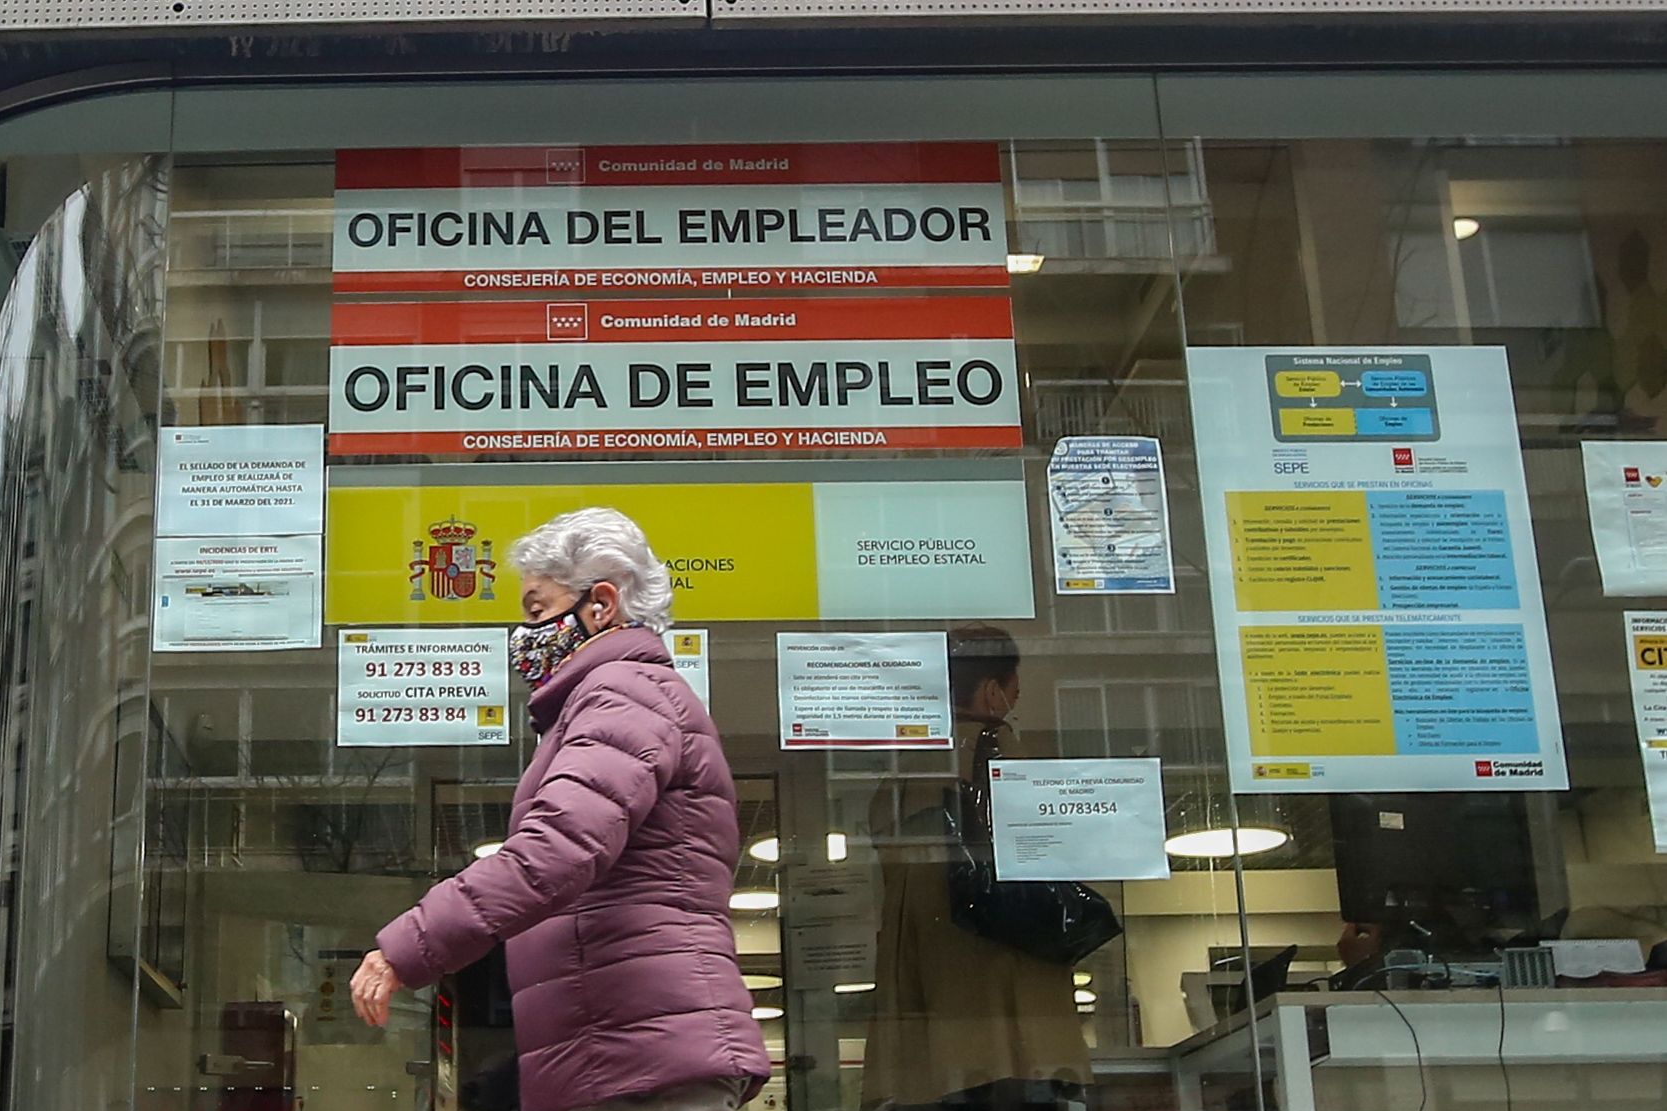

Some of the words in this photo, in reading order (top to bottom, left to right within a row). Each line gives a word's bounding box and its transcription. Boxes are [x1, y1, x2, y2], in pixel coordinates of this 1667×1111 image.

[598, 158, 697, 172] Comunidad
[702, 158, 724, 171] de
[729, 158, 789, 171] Madrid
[347, 211, 551, 247] OFICINA
[566, 210, 663, 245] DEL
[678, 207, 992, 243] EMPLEADOR
[464, 270, 567, 287] CONSEJERÍA
[574, 273, 596, 286] DE
[601, 269, 697, 287] ECONOMÍA,
[702, 272, 771, 285] EMPLEO
[775, 272, 786, 284] Y
[791, 271, 877, 284] HACIENDA
[600, 314, 702, 328] Comunidad
[707, 314, 729, 326] de
[735, 313, 796, 326] Madrid
[1293, 357, 1324, 365] Sistema
[1326, 357, 1360, 365] Nacional
[1373, 357, 1402, 366] Empleo
[344, 364, 608, 412] OFICINA
[628, 362, 713, 408] DE
[735, 359, 1003, 407] EMPLEO
[463, 431, 572, 448] CONSEJERÍA
[576, 434, 600, 447] DE
[604, 431, 702, 448] ECONOMÍA,
[707, 433, 777, 446] EMPLEO
[782, 432, 794, 445] Y
[798, 431, 887, 445] HACIENDA
[251, 461, 293, 469] DEMANDA
[1273, 462, 1310, 474] SEPE
[237, 472, 280, 481] REALIZARÁ
[219, 484, 274, 493] AUTOMÁTICA
[276, 484, 302, 492] HASTA
[1357, 480, 1389, 488] PRESTAN
[1390, 480, 1400, 488] EN
[1401, 480, 1433, 488] OFICINAS
[225, 498, 255, 506] MARZO
[273, 497, 295, 505] 2021.
[199, 546, 246, 554] INCIDENCIAS
[260, 545, 278, 553] ERTE
[857, 540, 915, 551] SERVICIO
[919, 537, 976, 550] PÚBLICO
[665, 558, 735, 571] ACIONES
[858, 554, 876, 565] DE
[879, 554, 930, 565] EMPLEO
[934, 553, 986, 565] ESTATAL
[1297, 615, 1334, 623] SERVICIOS
[1396, 613, 1462, 622] TELEMÁTICAMENTE
[355, 643, 406, 654] TRÁMITES
[408, 645, 413, 653] E
[415, 642, 492, 653] INFORMACIÓN:
[1640, 647, 1667, 665] CI
[365, 662, 387, 677] 91
[393, 662, 426, 676] 273
[432, 661, 453, 676] 83
[459, 661, 481, 676] 83
[676, 660, 700, 669] SEPE
[873, 660, 881, 668] AL
[882, 660, 921, 668] CIUDADANO
[405, 686, 434, 698] CITA
[438, 686, 489, 697] PREVIA:
[355, 708, 376, 722] 91
[382, 707, 414, 722] 273
[419, 707, 439, 721] 83
[445, 707, 466, 721] 84
[478, 731, 503, 740] SEPE
[1492, 760, 1543, 768] Comunidad
[1509, 768, 1544, 776] Madrid
[1032, 778, 1064, 786] TELÉFONO
[1104, 777, 1144, 785] COMUNIDAD
[1038, 803, 1056, 815] 91
[1059, 802, 1117, 815] 0783454
